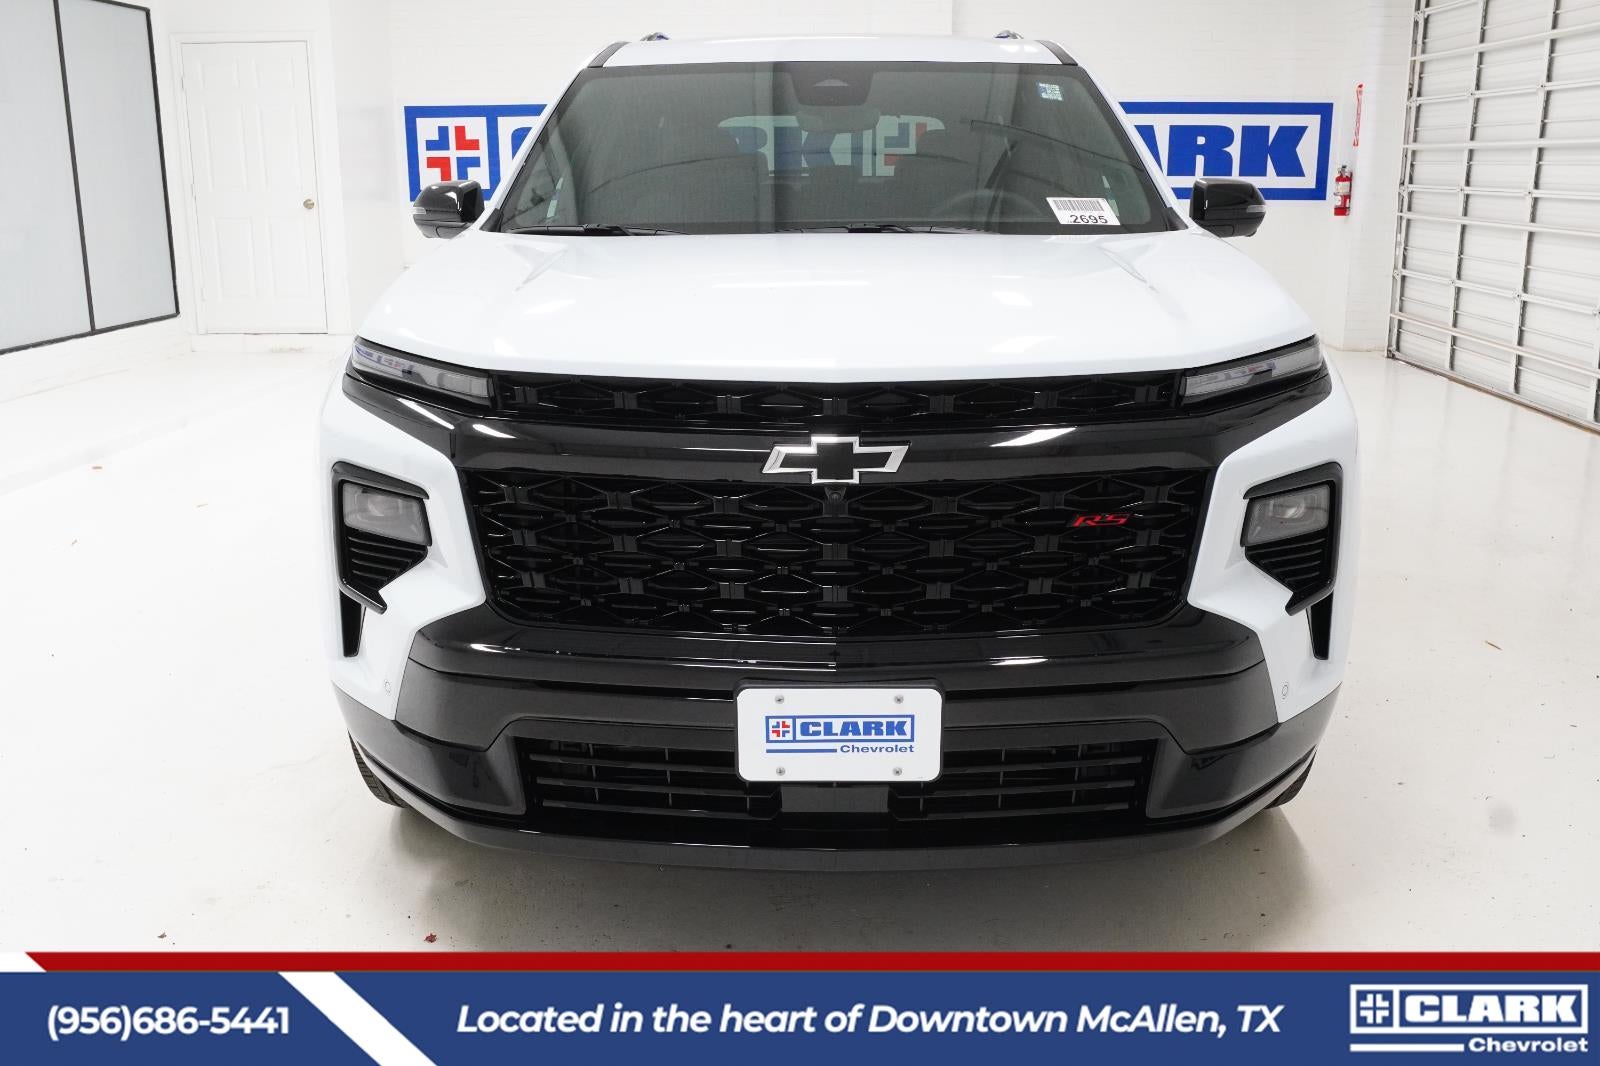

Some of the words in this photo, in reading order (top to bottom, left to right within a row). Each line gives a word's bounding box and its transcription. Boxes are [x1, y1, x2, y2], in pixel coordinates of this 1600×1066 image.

[1069, 214, 1108, 224] 2695
[1072, 513, 1129, 527] RS
[800, 720, 907, 737] CLARK
[840, 744, 914, 753] Chevrolet
